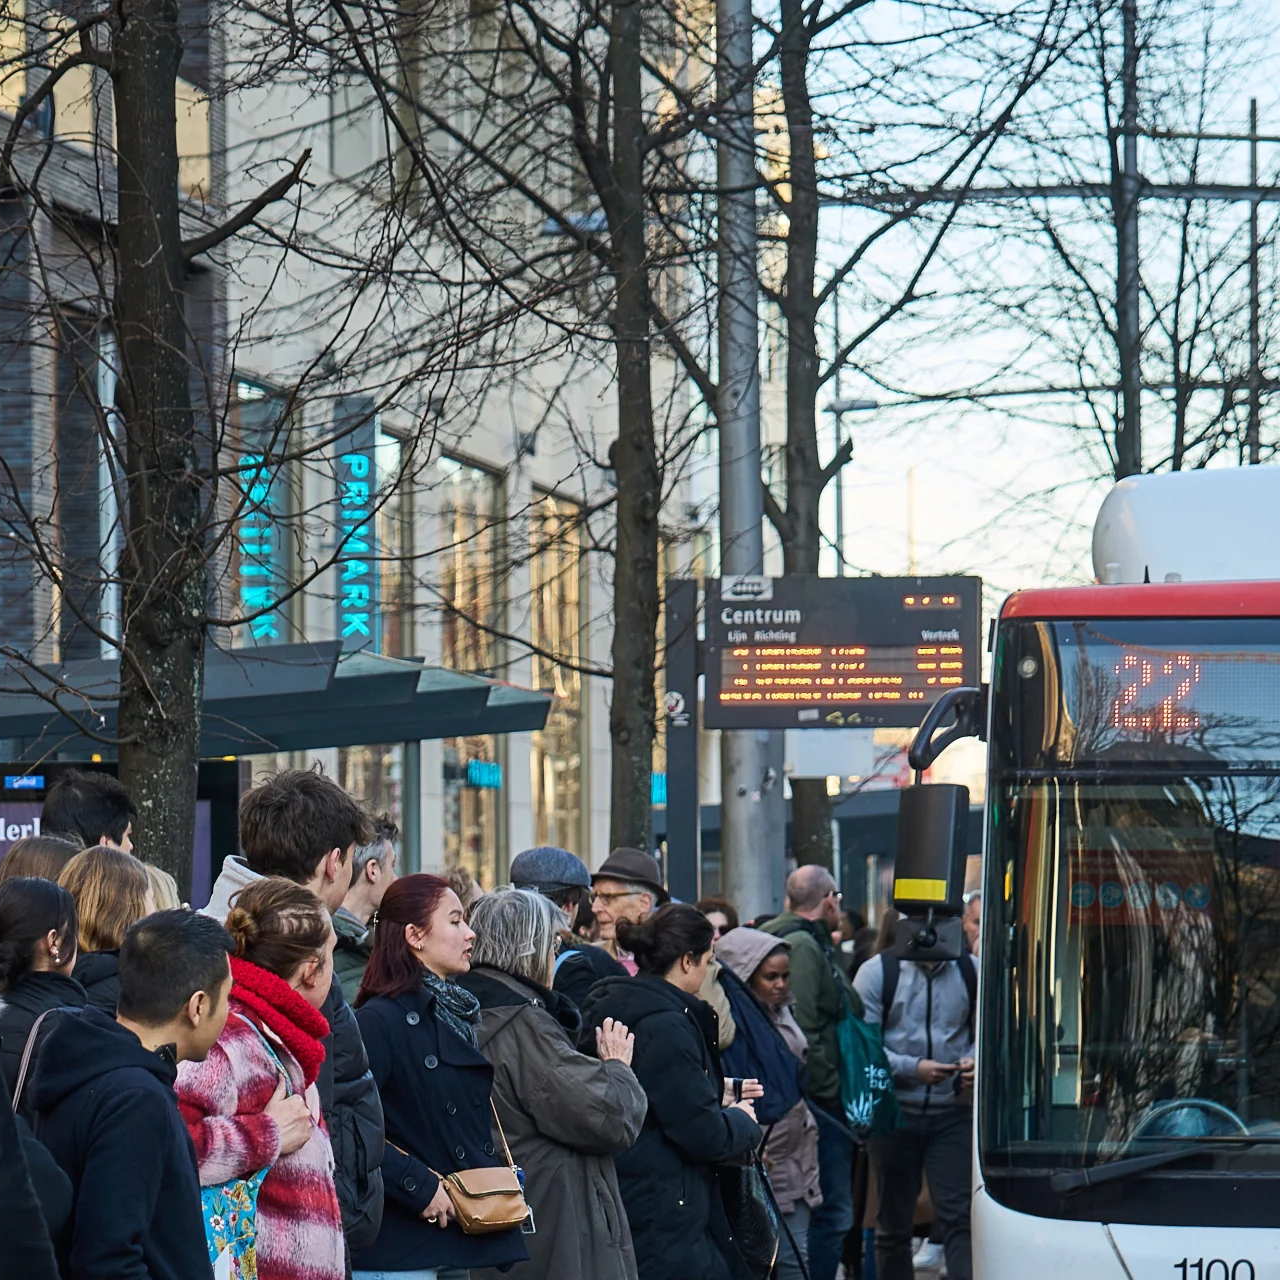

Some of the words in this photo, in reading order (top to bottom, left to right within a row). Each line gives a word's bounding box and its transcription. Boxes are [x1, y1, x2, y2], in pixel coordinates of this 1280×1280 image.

[340, 453, 371, 638] PRIMARK
[721, 607, 802, 626] Centrum
[728, 630, 748, 643] Lijn
[754, 630, 797, 643] Richting
[921, 628, 960, 642] Vertrek
[1114, 654, 1200, 729] 22
[12, 776, 37, 788] global
